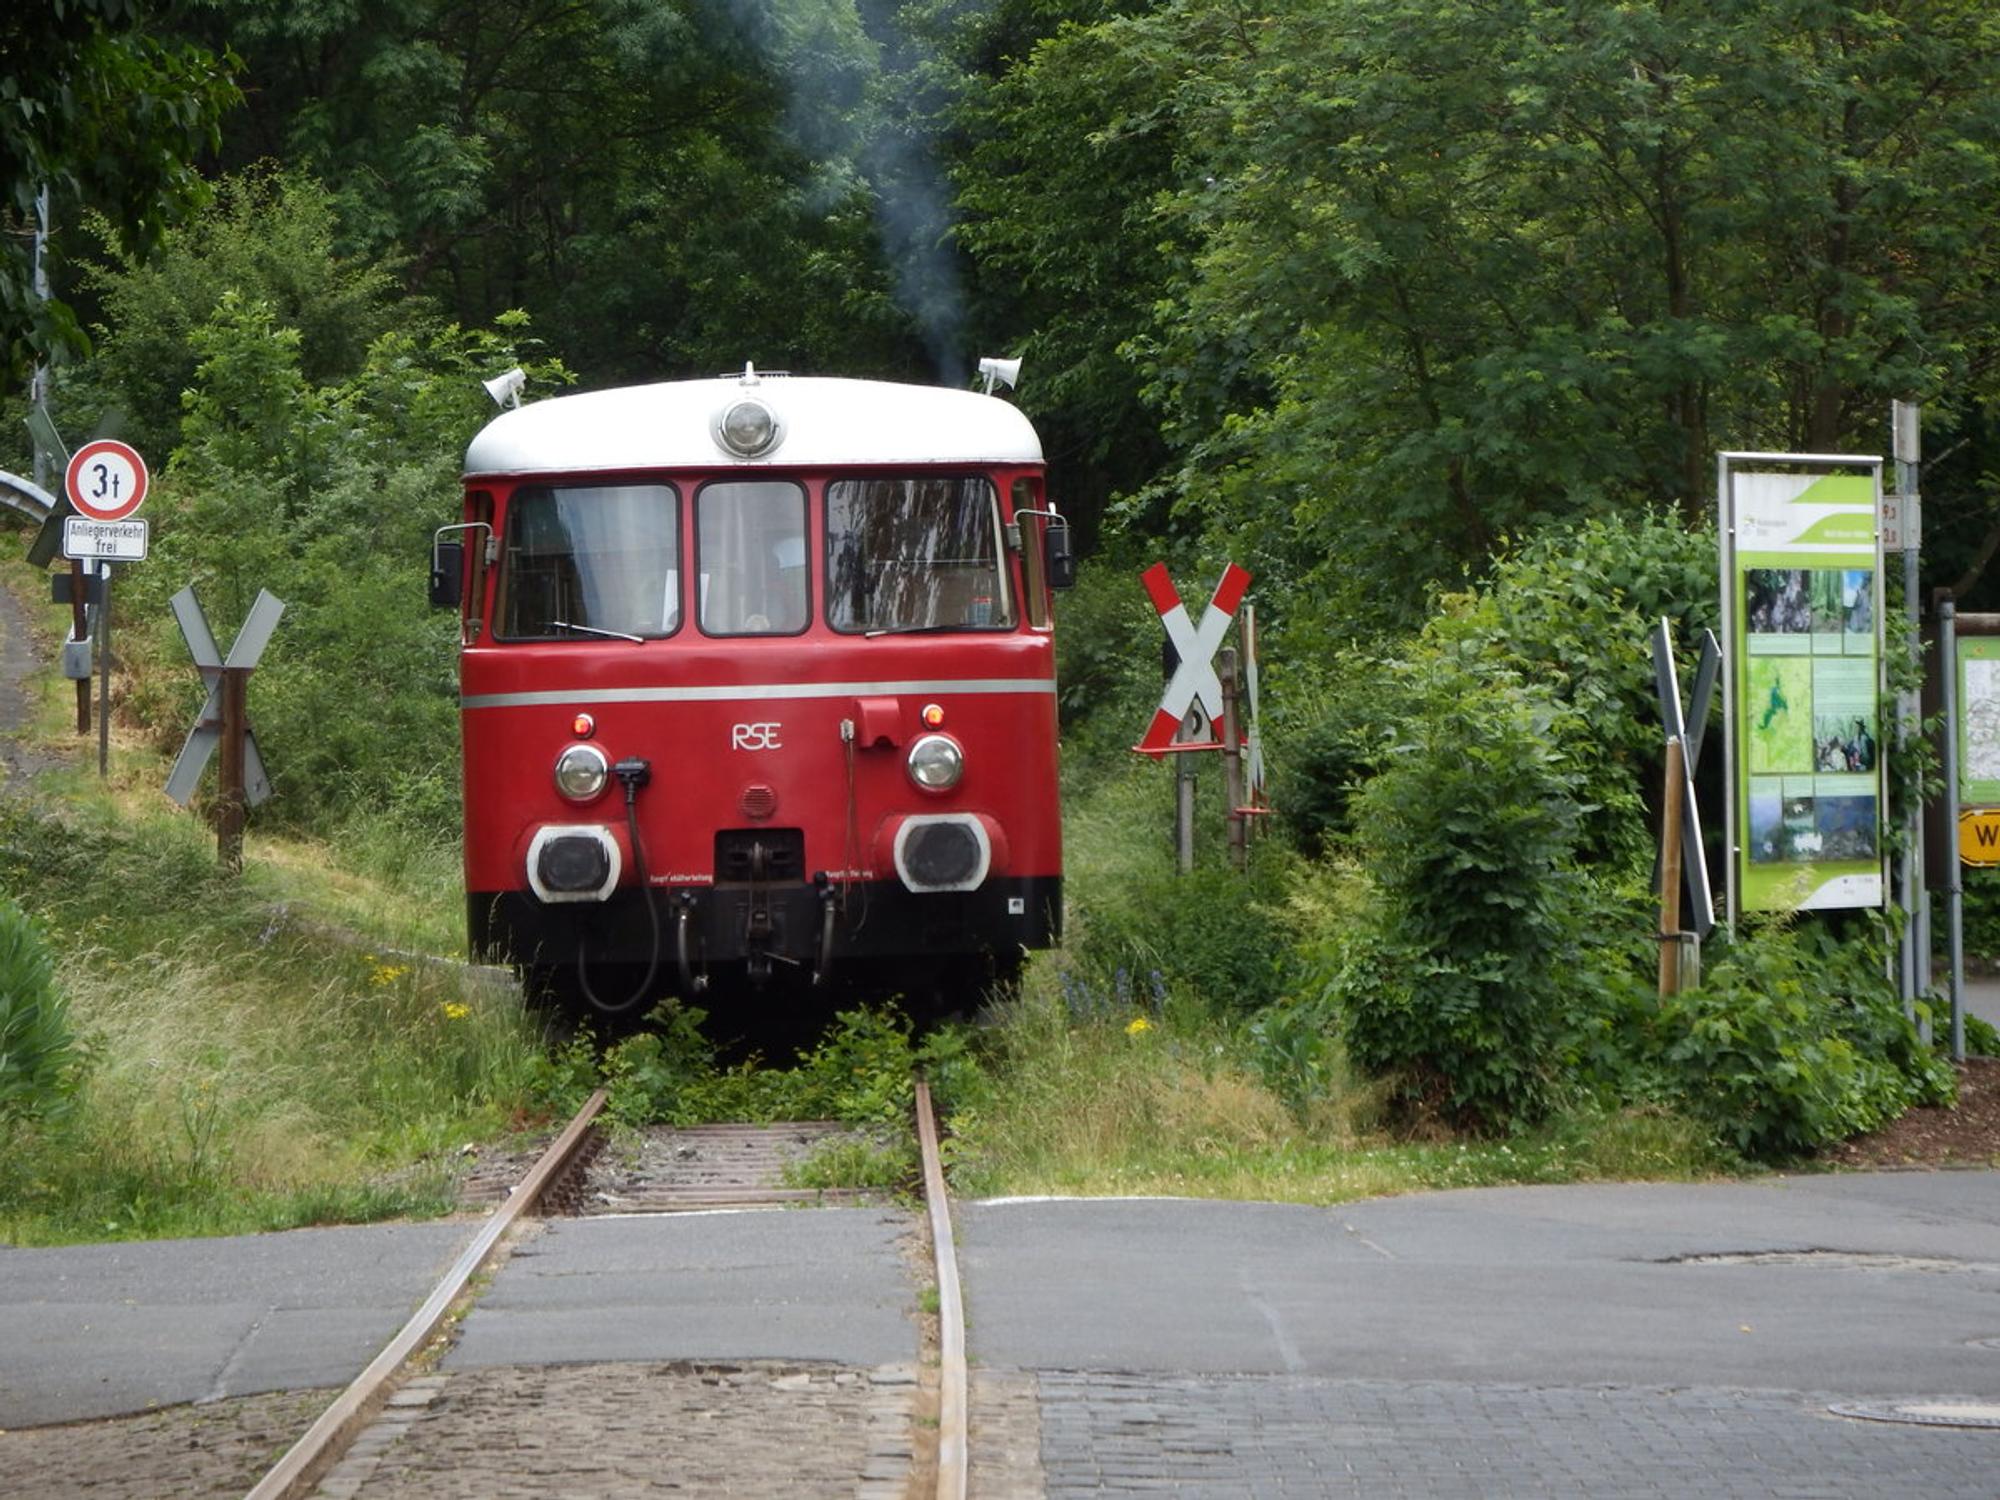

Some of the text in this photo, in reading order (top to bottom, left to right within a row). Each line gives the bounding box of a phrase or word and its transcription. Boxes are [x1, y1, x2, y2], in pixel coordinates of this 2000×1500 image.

[71, 523, 143, 540] Anliegerverkehr
[96, 540, 117, 553] frei
[733, 723, 782, 750] RSE
